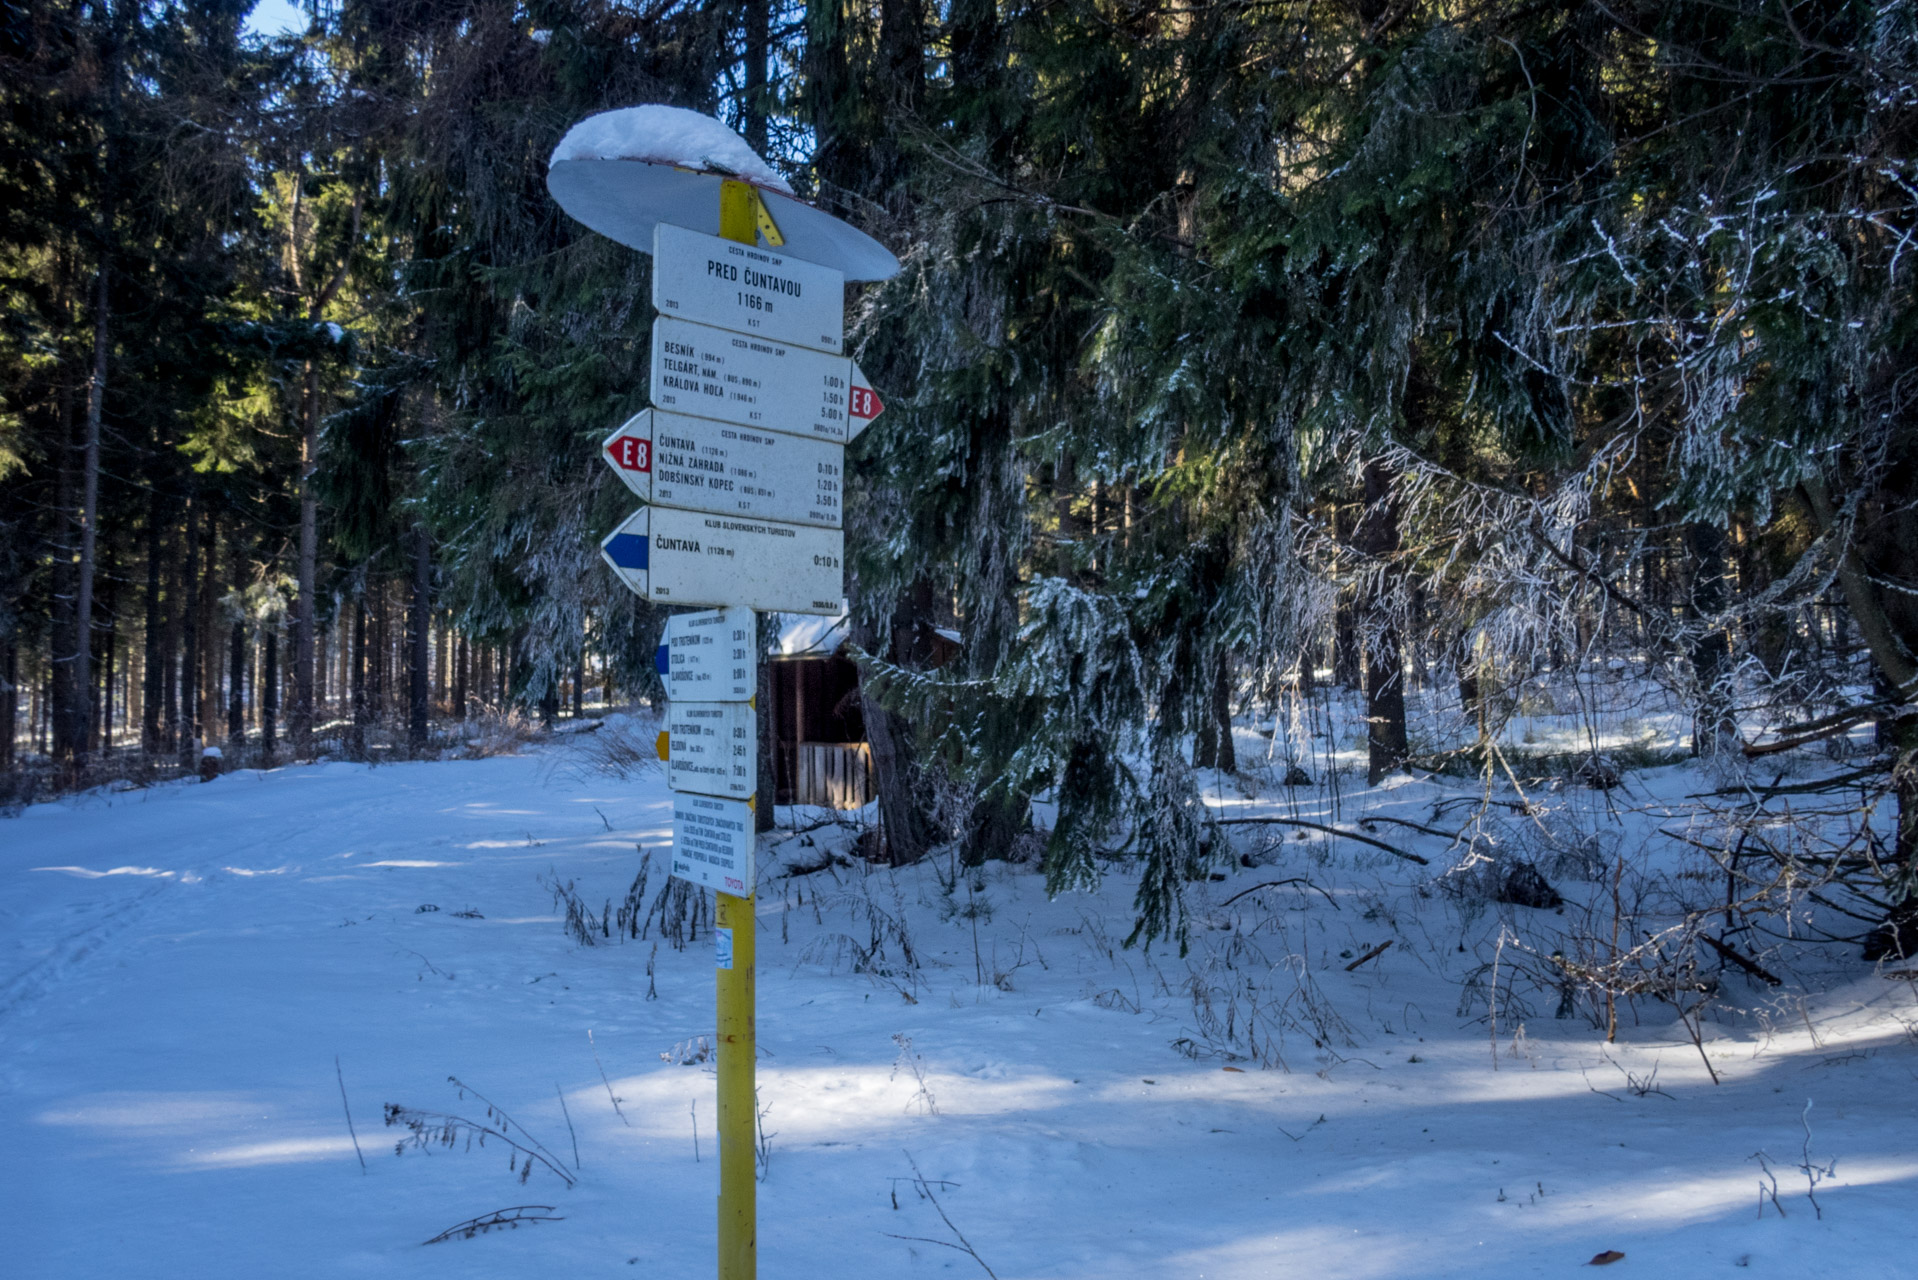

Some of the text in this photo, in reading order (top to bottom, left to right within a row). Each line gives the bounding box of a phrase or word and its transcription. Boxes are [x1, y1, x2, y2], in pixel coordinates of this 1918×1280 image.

[729, 246, 782, 266] CESTA HRDINOV SNP
[708, 260, 801, 297] PRED ČUNTAVOU
[666, 299, 679, 310] 2013
[765, 301, 773, 313] m
[664, 341, 695, 358] BESNÍK
[732, 339, 748, 348] CESTA
[750, 343, 773, 354] HRDINOV
[664, 358, 700, 377] TELGÁRT,
[664, 375, 699, 392] KRÁLOVA
[704, 384, 724, 398] HOĽA
[662, 394, 676, 404] 2013
[659, 433, 695, 452] ČUNTAVA
[721, 430, 737, 440] CESTA
[765, 437, 775, 446] SNP
[659, 452, 684, 467] NIŽNÁ
[689, 457, 724, 474] ZÁHRADA
[659, 469, 704, 486] DOBŠINSKÝ
[709, 477, 734, 492] KOPEC
[658, 489, 672, 498] 2013
[705, 519, 795, 538] KLUB SLOVENSKÝCH TURISTOV
[656, 534, 700, 553] ČUNTAVA
[814, 555, 839, 568] 0:10 h
[655, 587, 670, 595] 2013
[724, 876, 744, 890] TOYOTA
